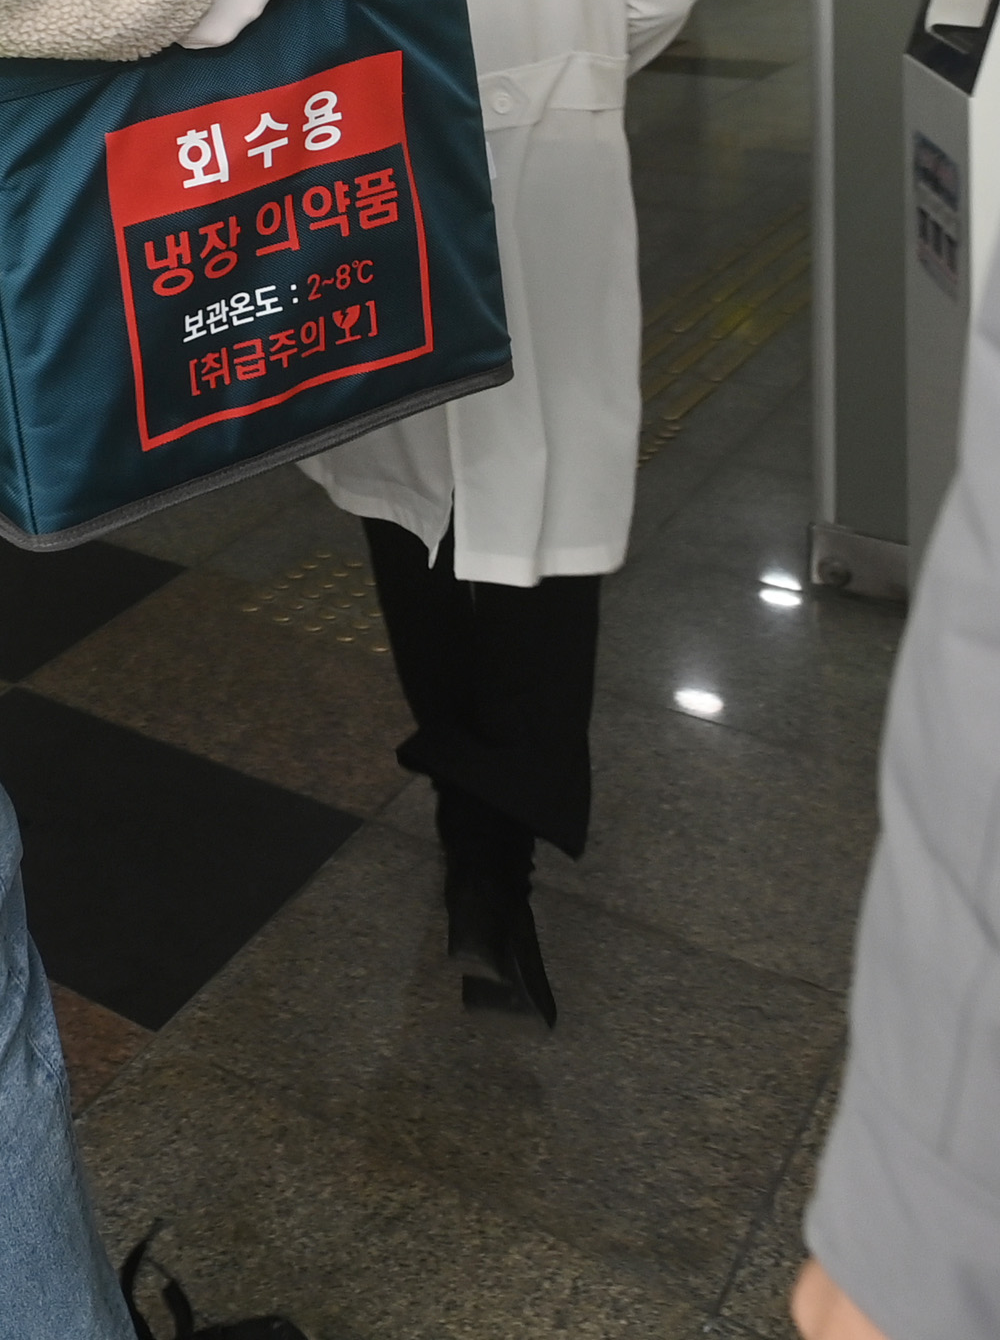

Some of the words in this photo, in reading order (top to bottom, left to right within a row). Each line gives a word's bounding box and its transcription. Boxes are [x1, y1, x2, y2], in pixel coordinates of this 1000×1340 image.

[176, 90, 342, 189] 회수용
[144, 216, 241, 297] 냉장
[255, 168, 399, 257] 의약품
[183, 285, 283, 344] 보관온도
